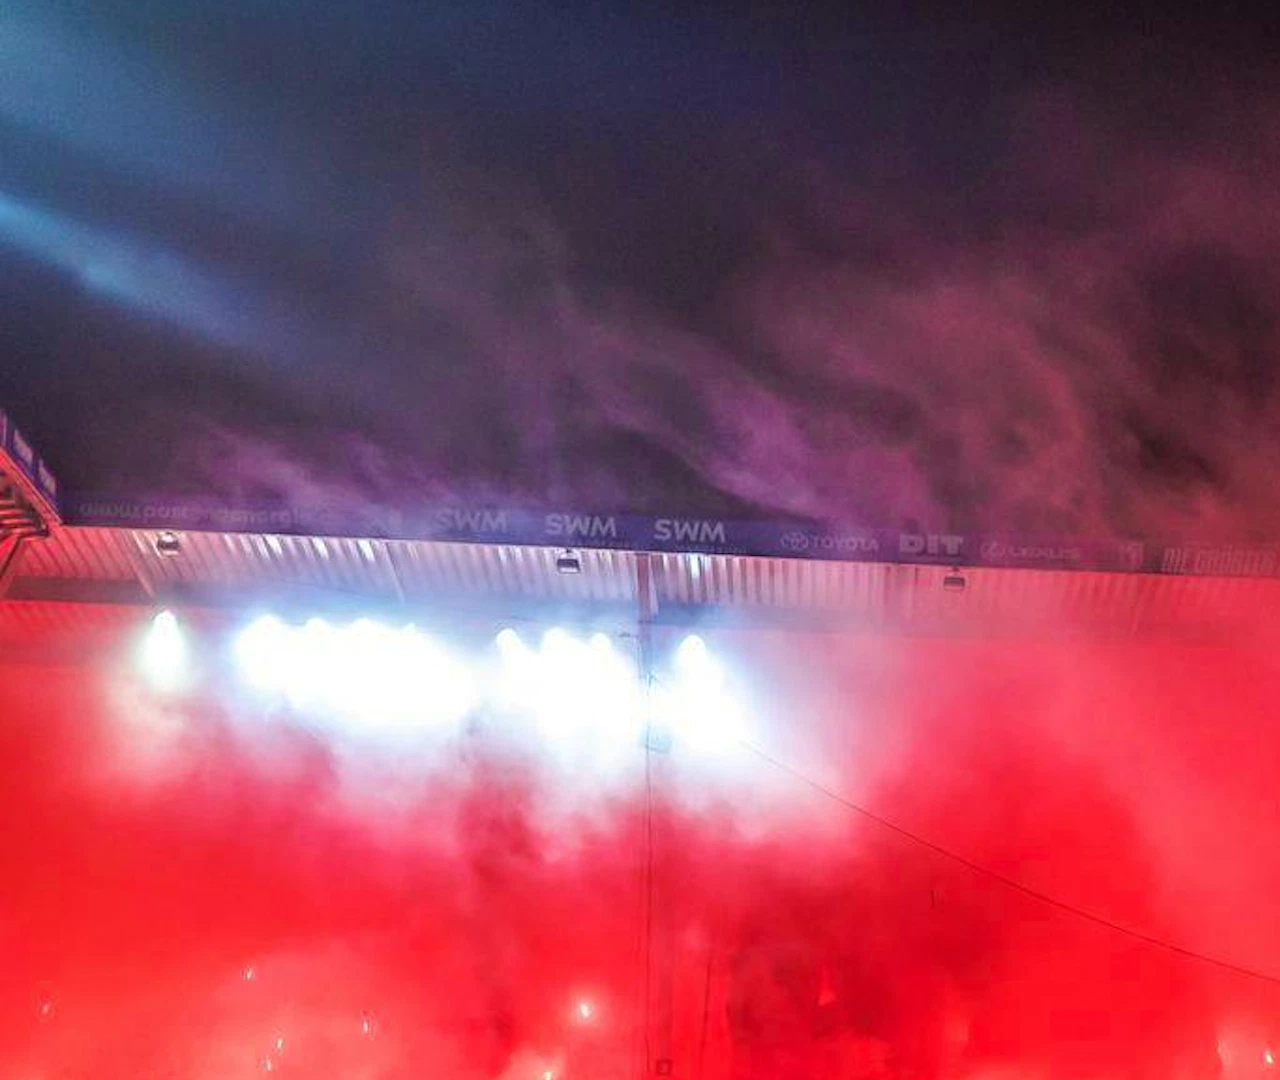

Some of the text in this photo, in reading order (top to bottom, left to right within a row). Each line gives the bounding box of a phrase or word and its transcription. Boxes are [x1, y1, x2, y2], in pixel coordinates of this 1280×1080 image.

[544, 514, 617, 538] SWM
[653, 519, 725, 543] SWM
[810, 536, 879, 552] TOYOTA
[900, 535, 964, 556] DIT
